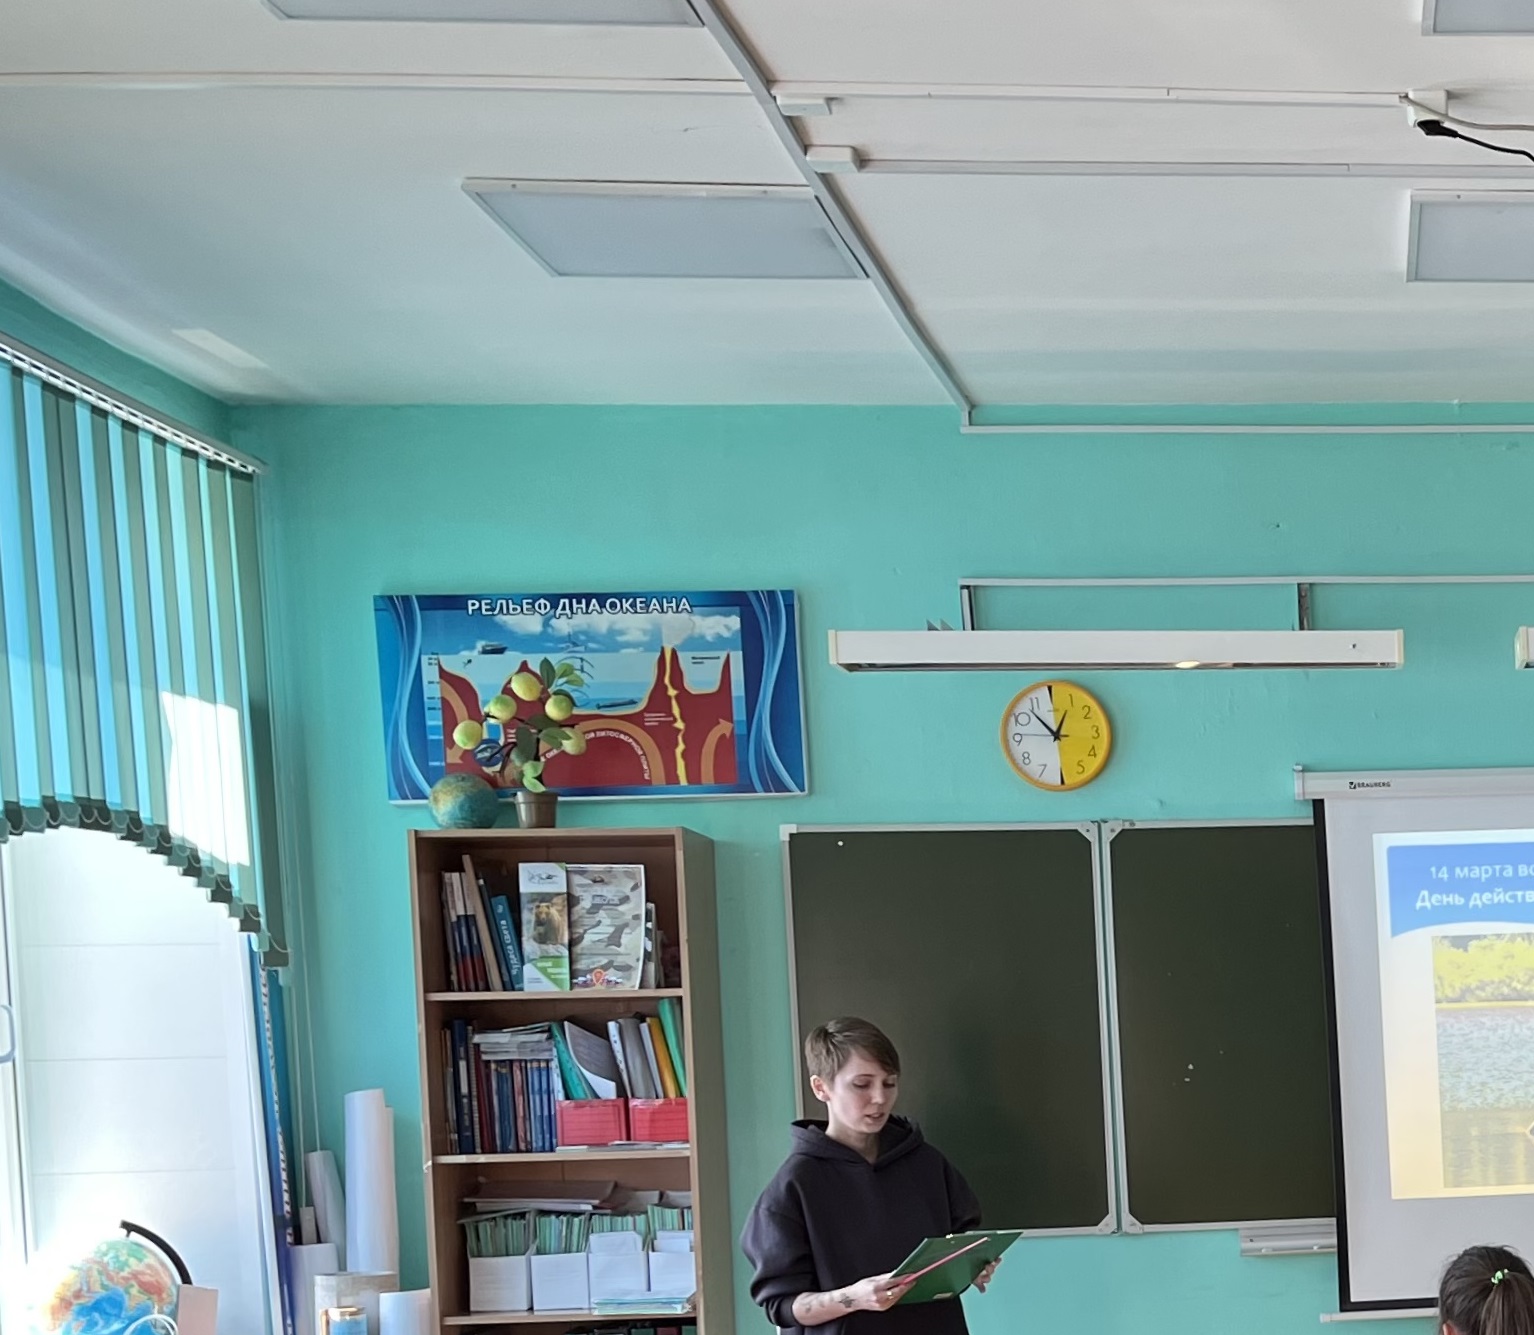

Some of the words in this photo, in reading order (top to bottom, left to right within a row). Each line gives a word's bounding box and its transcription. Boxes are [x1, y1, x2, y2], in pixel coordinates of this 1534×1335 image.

[467, 598, 551, 616] РЕЛЬЕФ
[554, 598, 602, 619] ДНА
[605, 597, 693, 615] ОКЕАНА
[1029, 697, 1040, 711] 11
[1068, 694, 1074, 707] 1
[1013, 711, 1031, 727] 10
[1081, 705, 1092, 719] 2
[1012, 733, 1023, 746] 9
[1091, 724, 1100, 740] 3
[1022, 751, 1032, 766] 8
[1087, 745, 1098, 759] 4
[1038, 763, 1048, 778] 7
[1076, 760, 1086, 775] 5
[1430, 866, 1449, 882] 14
[1454, 864, 1513, 882] марта
[1415, 889, 1465, 911] День
